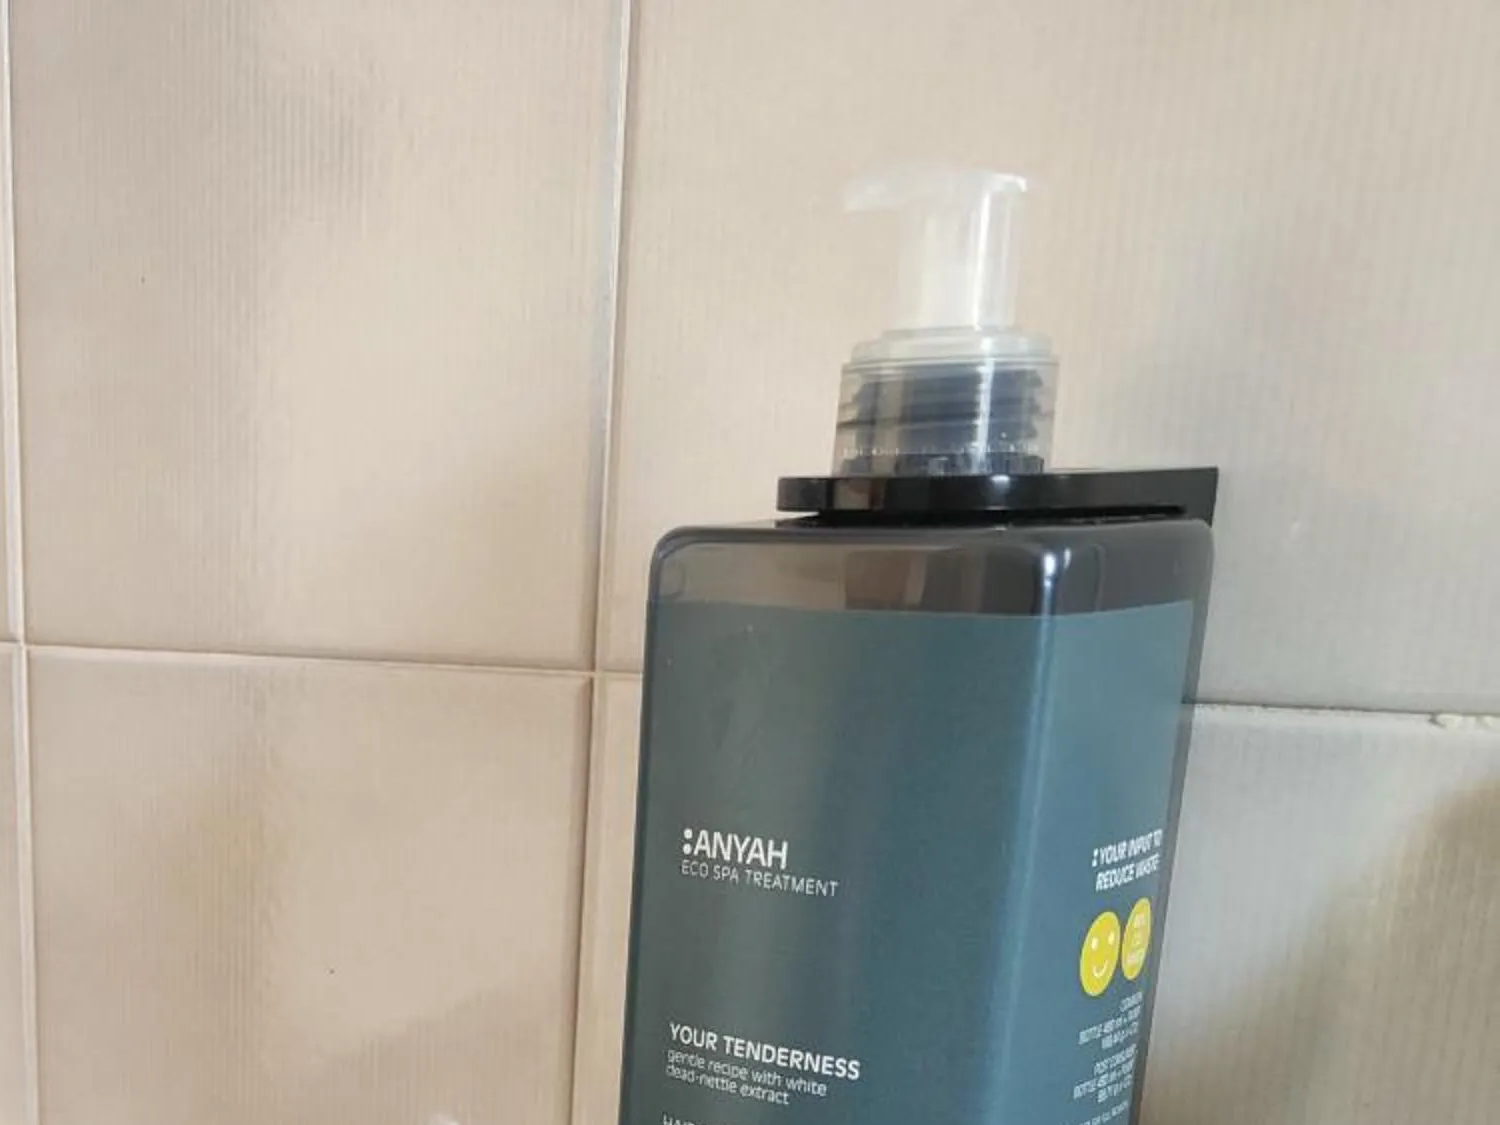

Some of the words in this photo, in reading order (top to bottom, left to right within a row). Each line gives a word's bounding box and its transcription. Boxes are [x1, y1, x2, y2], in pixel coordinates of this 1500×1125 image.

[681, 860, 709, 879] ECO
[713, 865, 739, 885] SPA
[744, 869, 839, 897] TREATMENT
[669, 1022, 718, 1051] YOUR
[723, 1035, 861, 1081] TENDERNESS
[665, 1065, 738, 1093] dead-nettle
[740, 1083, 789, 1105] extract
[667, 1050, 705, 1069] gentle
[708, 1060, 749, 1081] recipe
[751, 1069, 783, 1087] with
[785, 1076, 828, 1097] white
